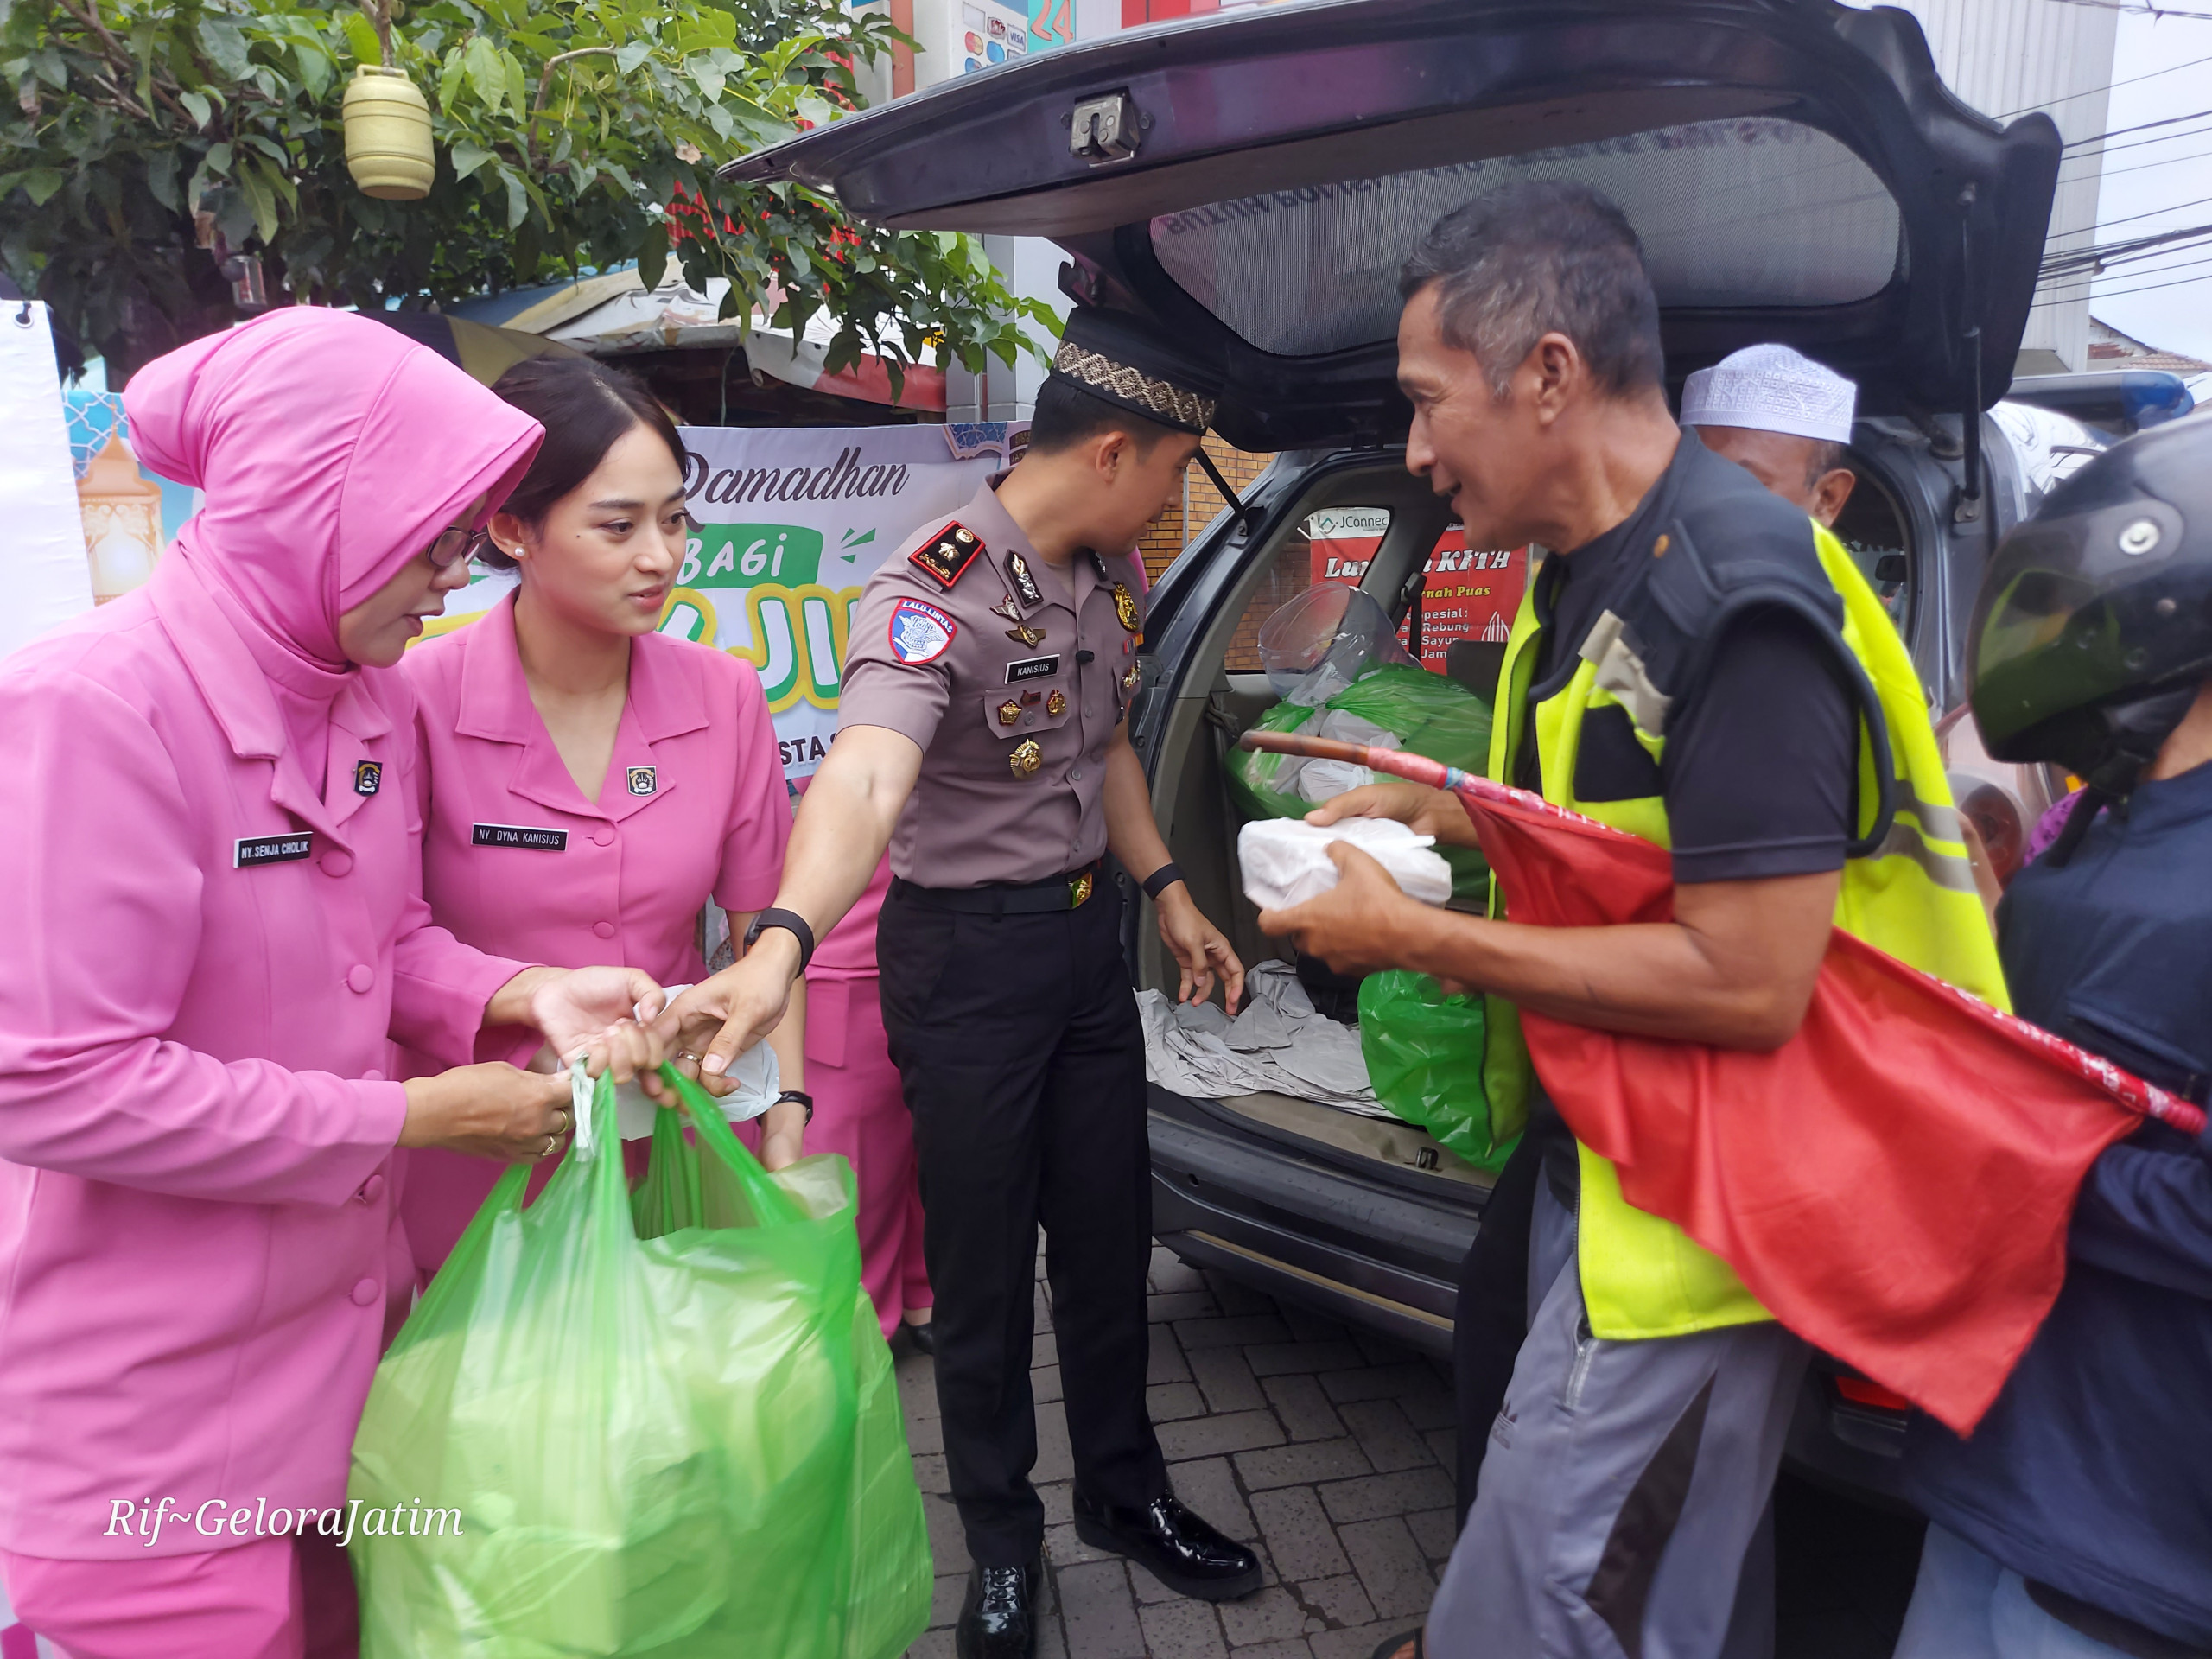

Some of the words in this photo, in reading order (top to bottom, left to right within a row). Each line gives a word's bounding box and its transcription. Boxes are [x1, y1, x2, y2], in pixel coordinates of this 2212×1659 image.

[1010, 31, 1024, 46] VISA
[1456, 586, 1491, 597] Puas
[1422, 622, 1469, 633] Rebung
[1017, 663, 1050, 677] KANISIUS
[496, 830, 518, 842] DYNA
[522, 832, 560, 846] KANISIUS
